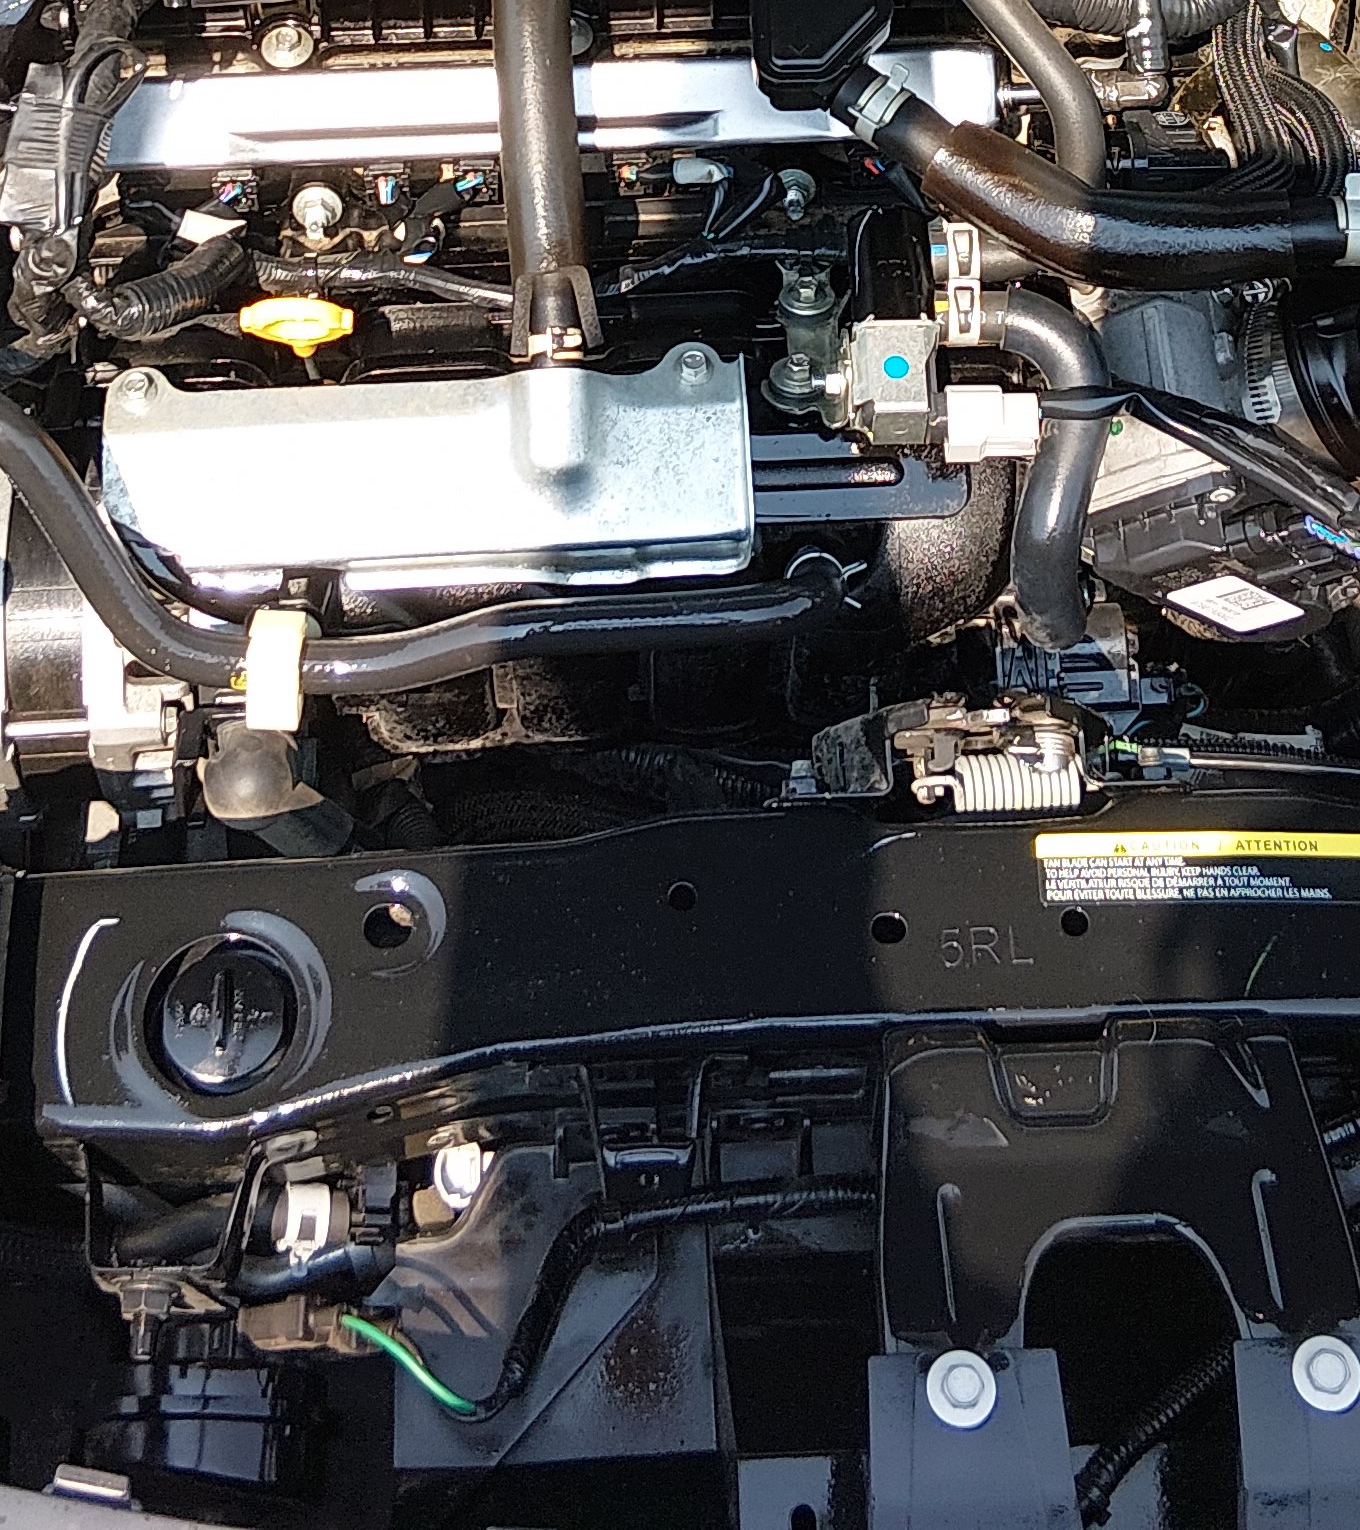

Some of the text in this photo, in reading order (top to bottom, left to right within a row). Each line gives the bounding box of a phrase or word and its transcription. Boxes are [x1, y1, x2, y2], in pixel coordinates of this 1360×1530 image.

[1236, 840, 1319, 851] ATTENTION
[1046, 869, 1057, 878] TO
[1202, 866, 1231, 875] HANDS
[1224, 877, 1248, 886] TOUT
[941, 925, 1034, 968] 5RL
